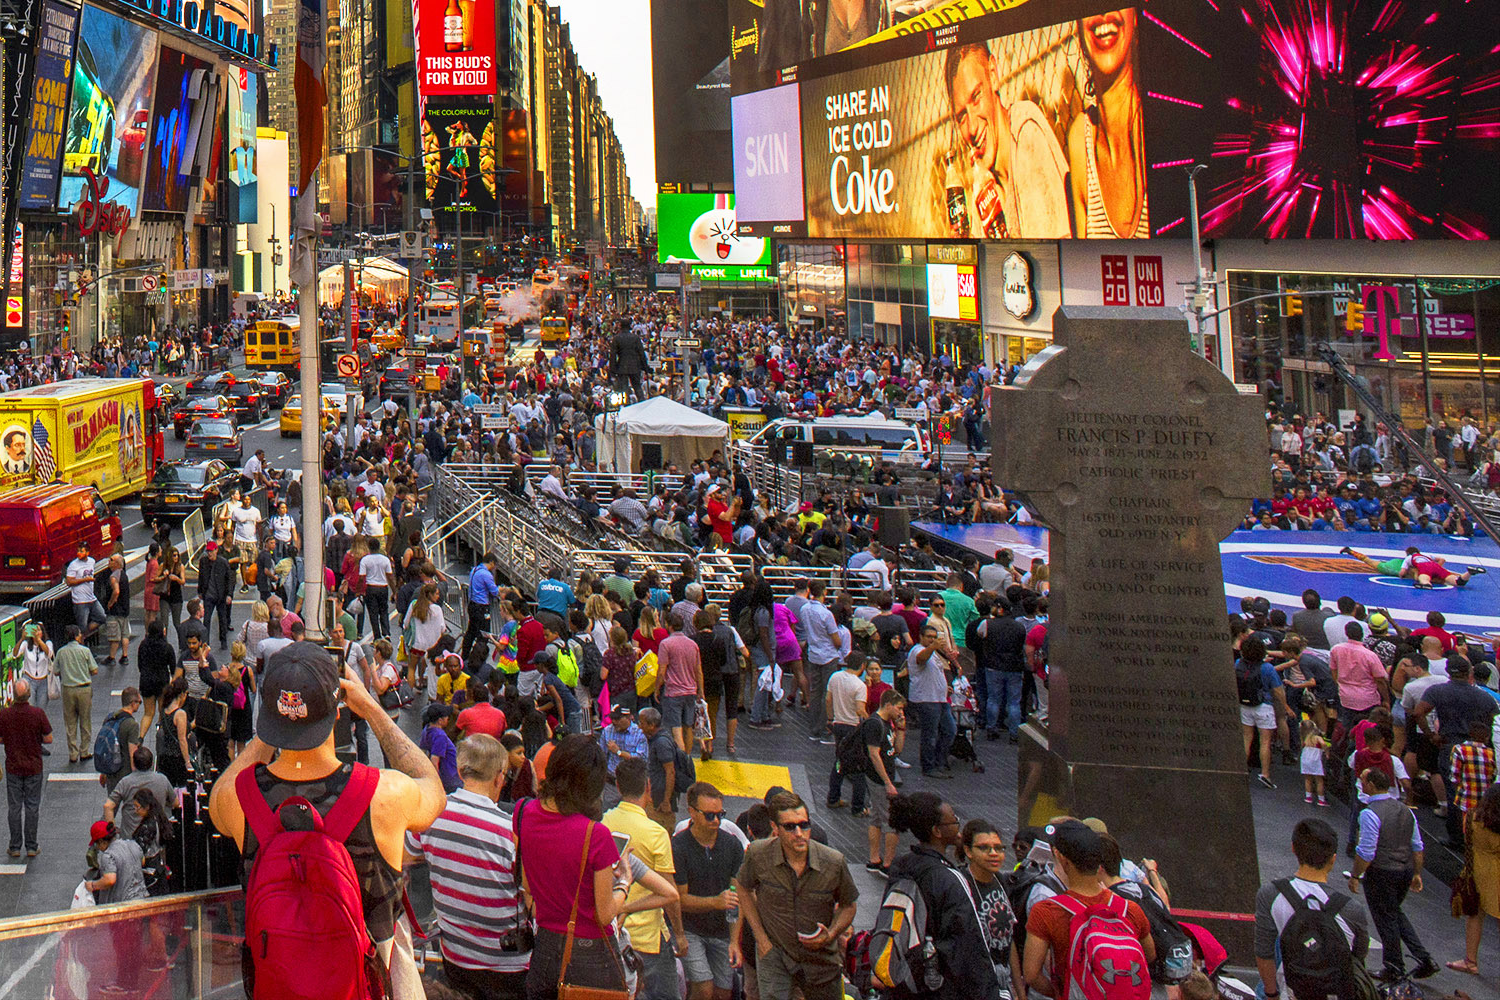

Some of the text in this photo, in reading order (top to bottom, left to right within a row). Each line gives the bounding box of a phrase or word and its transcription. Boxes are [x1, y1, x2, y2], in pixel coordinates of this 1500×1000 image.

[426, 55, 491, 70] THIS BUD'S
[426, 71, 487, 86] FOR YOU
[35, 76, 67, 108] COME
[825, 85, 890, 121] SHARE AN
[28, 131, 62, 160] AWAY
[829, 119, 893, 154] ICE COLD
[745, 132, 788, 178] SKIN
[830, 155, 899, 216] Coke.
[699, 268, 763, 277] YORK LINE
[1137, 262, 1159, 281] UNI
[1143, 414, 1203, 428] COLONEL
[1057, 427, 1217, 446] FRANCIS DUFFY
[1152, 468, 1198, 481] PRIEST
[1153, 561, 1206, 573] SERVICE
